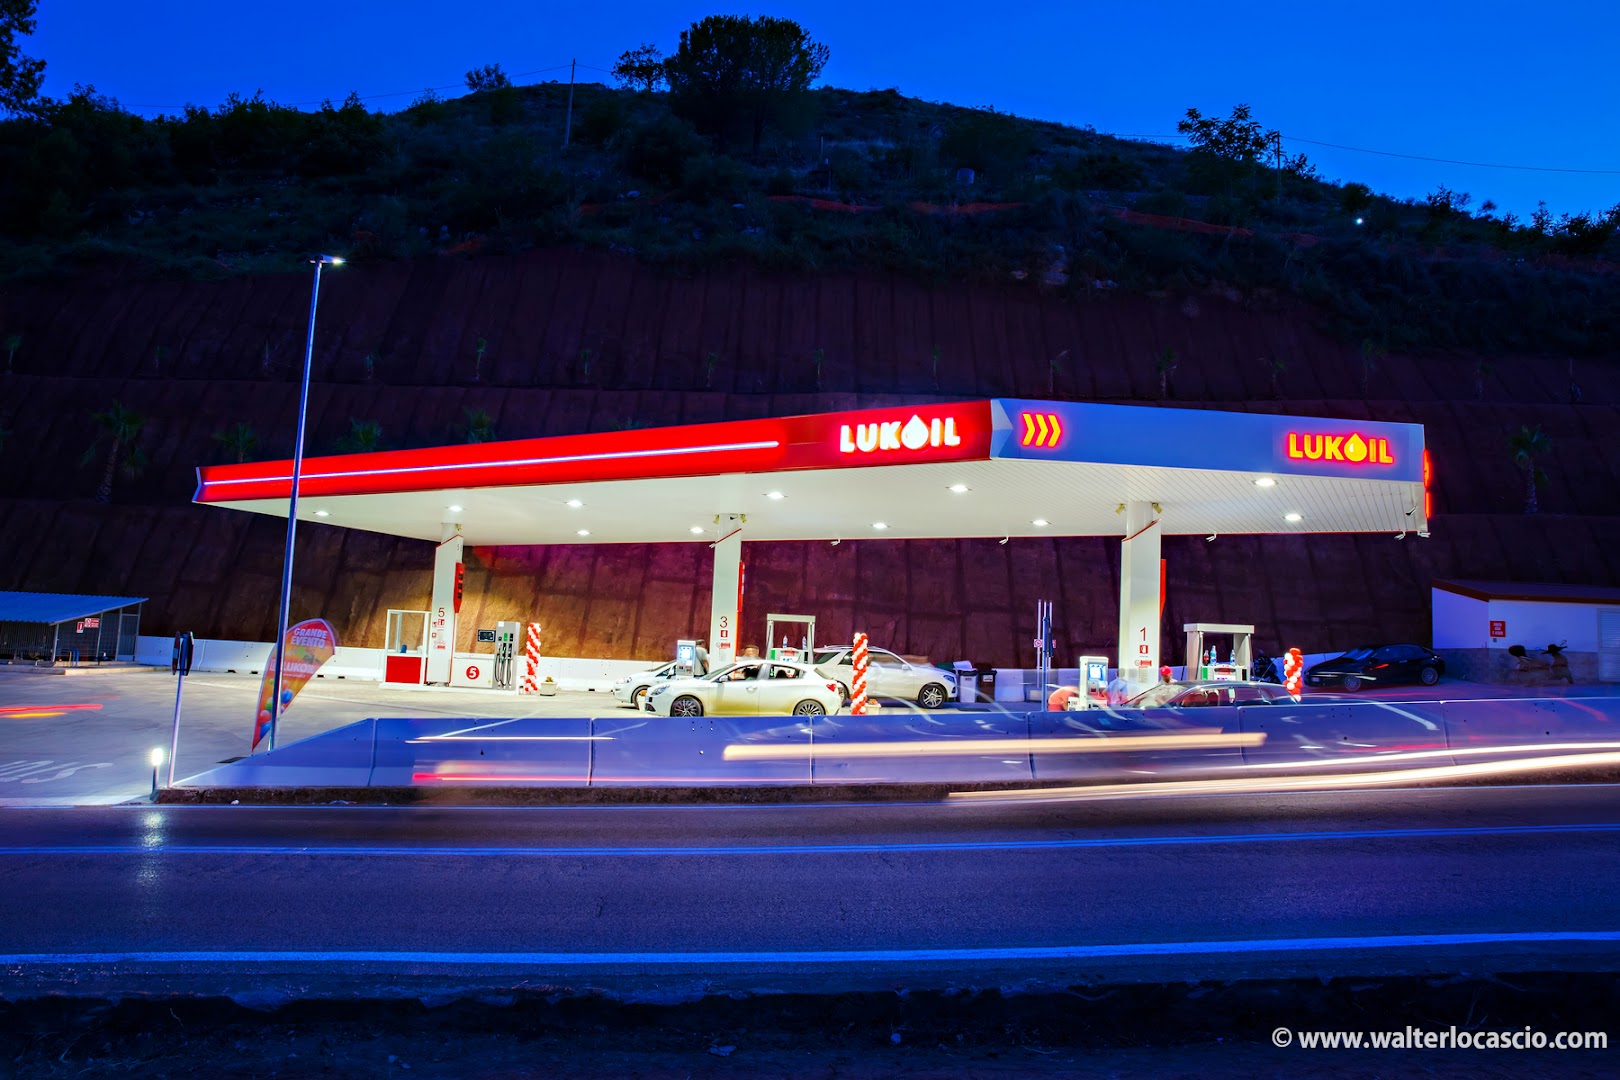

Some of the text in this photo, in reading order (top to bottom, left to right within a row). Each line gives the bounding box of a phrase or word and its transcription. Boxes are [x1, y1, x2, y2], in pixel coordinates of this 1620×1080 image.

[839, 414, 961, 453] LUKOIL
[1289, 433, 1394, 464] LUKOIL
[438, 607, 445, 618] 5
[719, 615, 728, 629] 3
[293, 627, 328, 639] GRANDE
[1139, 626, 1146, 642] 1
[290, 635, 326, 649] EVENTO
[468, 667, 477, 679] 5
